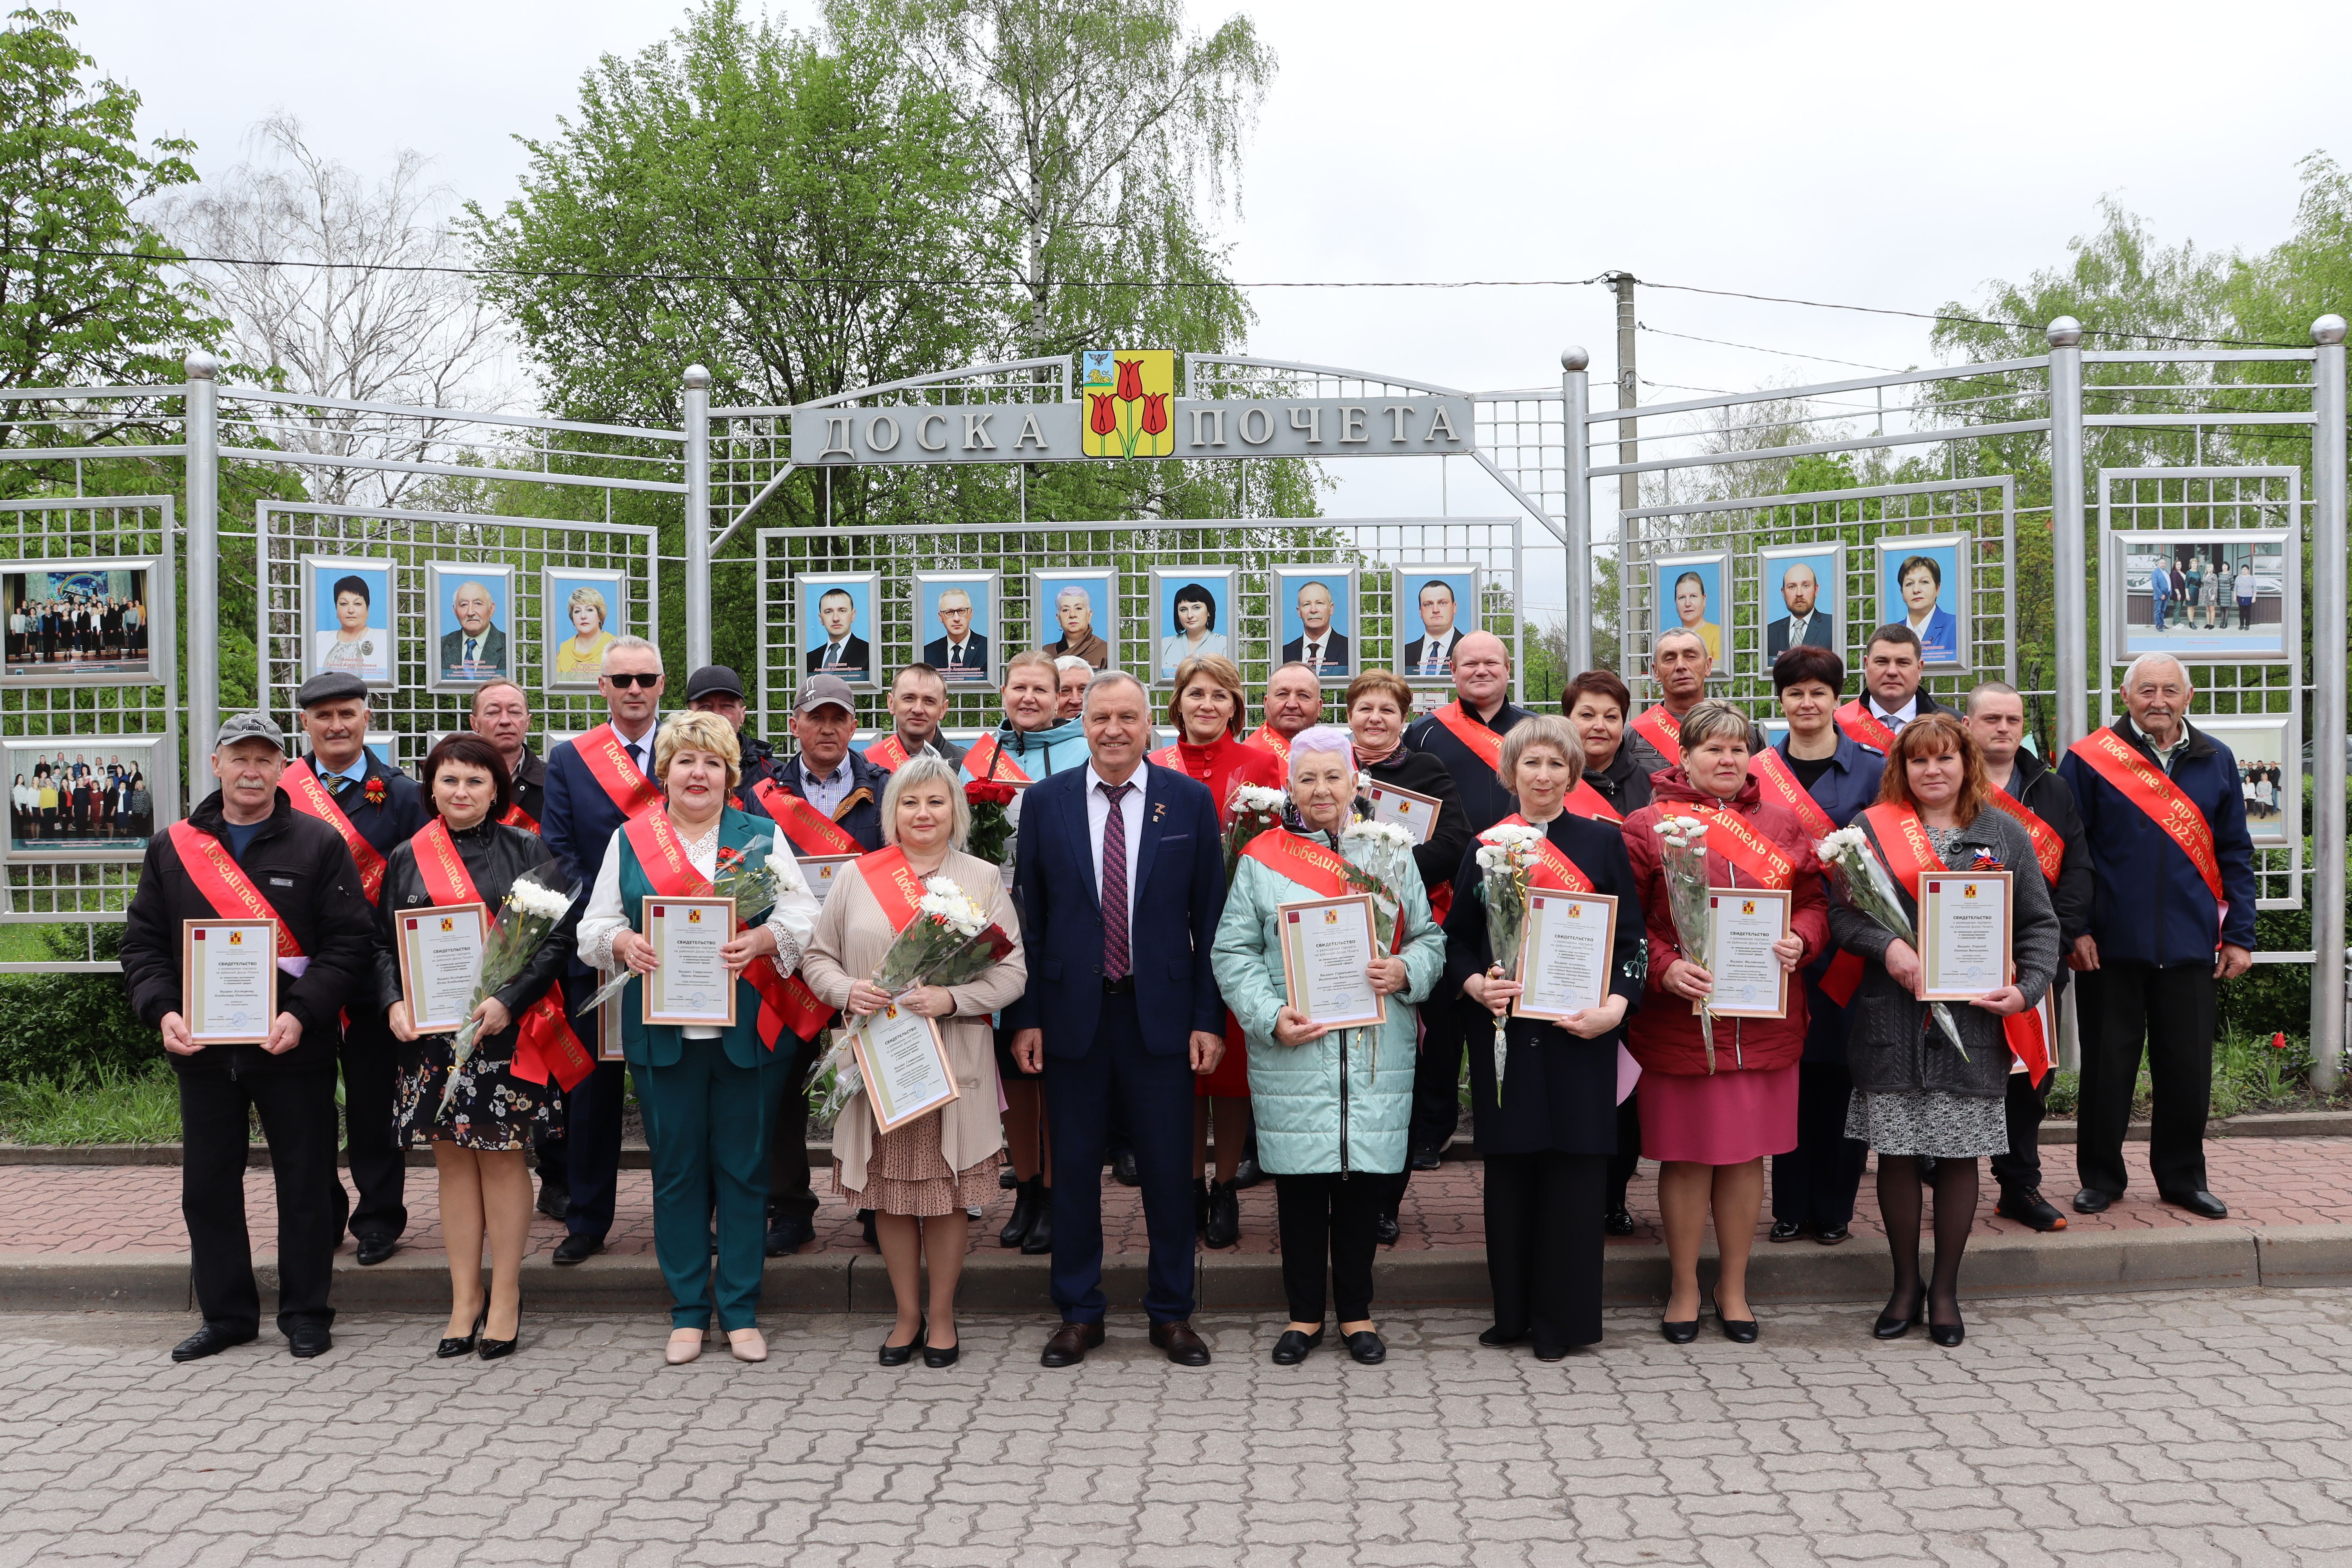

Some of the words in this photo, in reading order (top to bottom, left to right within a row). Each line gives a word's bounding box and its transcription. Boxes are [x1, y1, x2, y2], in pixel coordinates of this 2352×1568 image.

[818, 411, 1049, 461] ДОСКА
[1189, 403, 1461, 446] ПОЧЕТА
[1459, 711, 1502, 750] Победит
[603, 739, 657, 808] Победитель
[1756, 749, 1797, 803] обедитель
[2098, 734, 2171, 800] Победитель
[429, 821, 465, 899] Победитель
[648, 808, 681, 873] Победитель
[1900, 817, 1938, 872] Победит
[2161, 812, 2195, 846] 2023
[2192, 844, 2209, 875] года
[200, 839, 267, 919] Победитель
[892, 866, 920, 911] Победи
[534, 1000, 583, 1068] внования
[885, 1026, 916, 1045] СВИДЕТЕЛЬСТВО
[889, 1038, 906, 1049] размещении
[906, 1031, 918, 1040] портрета
[890, 1043, 904, 1053] районной
